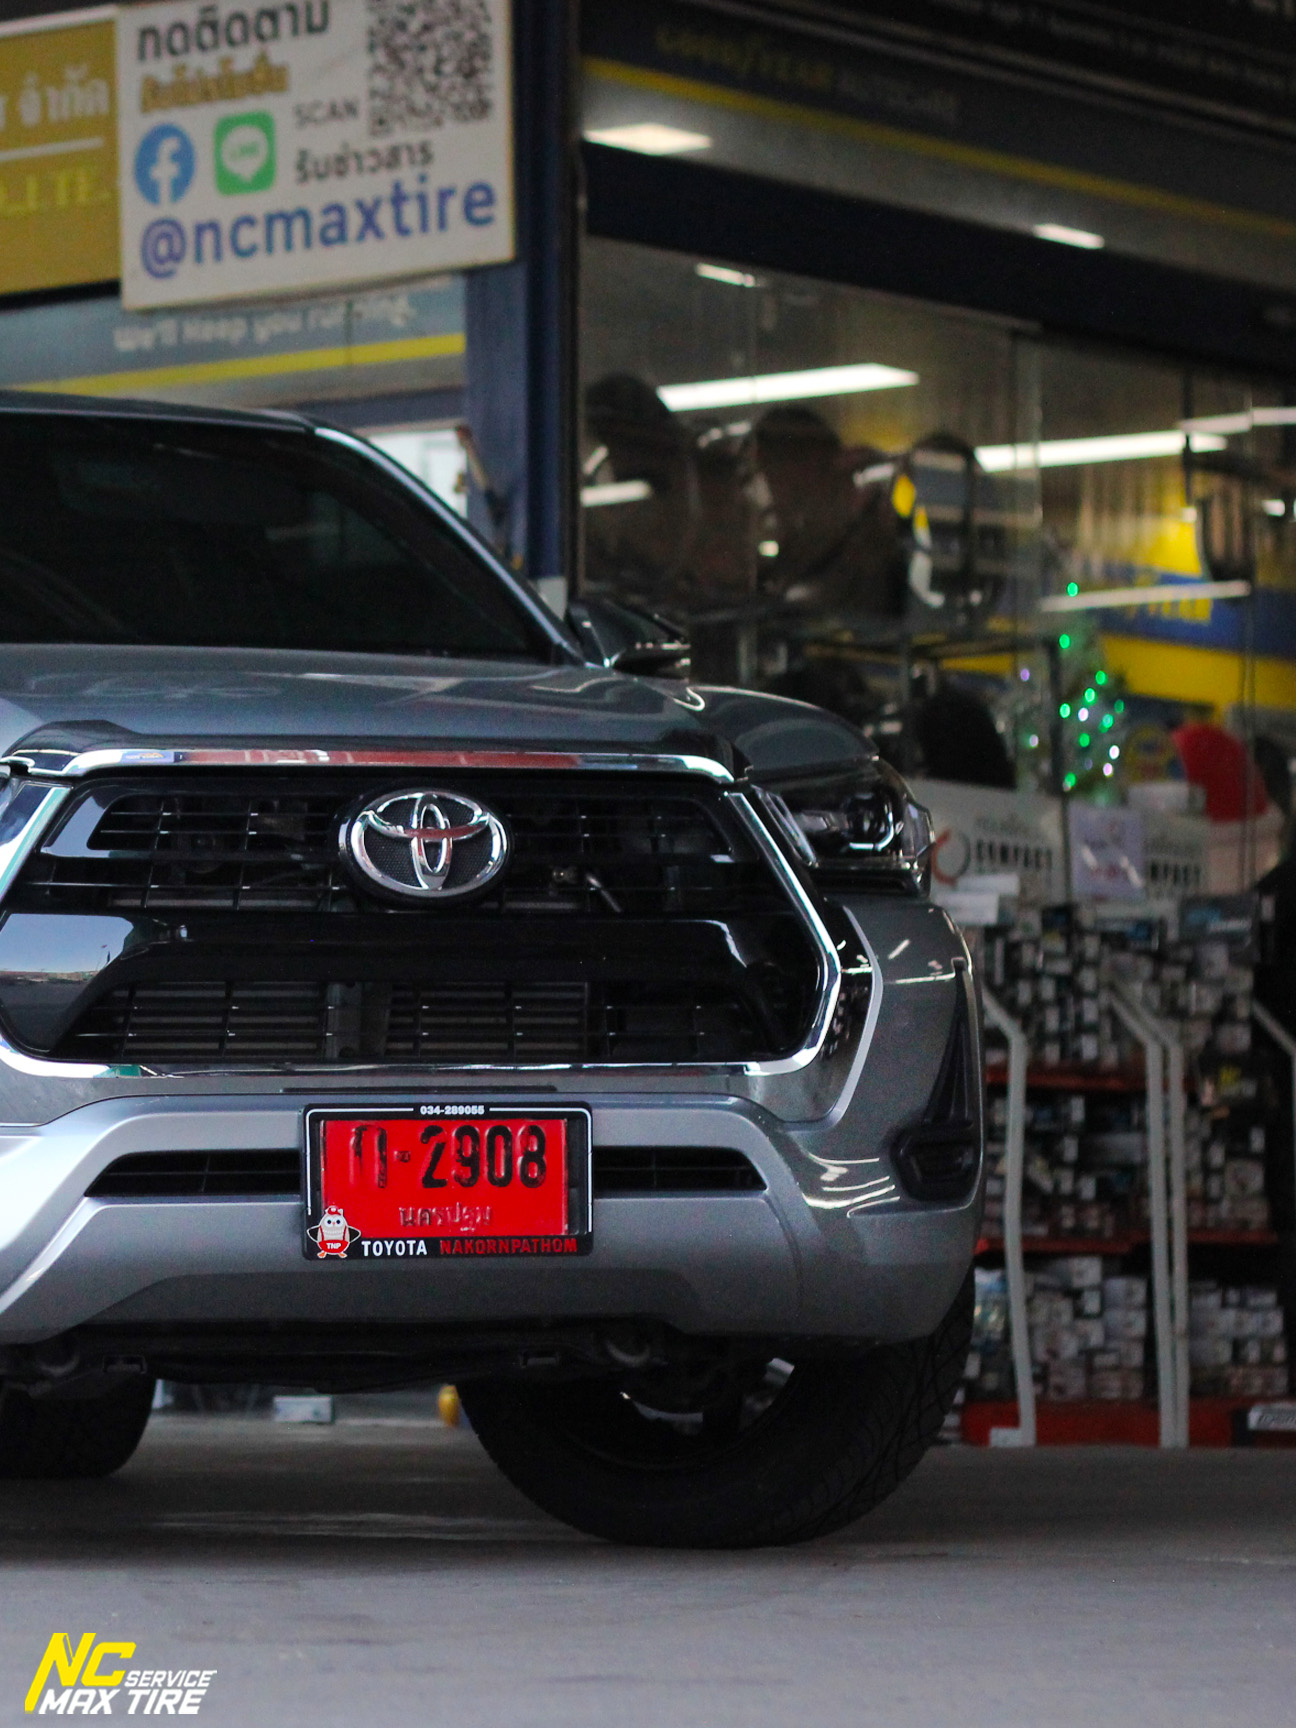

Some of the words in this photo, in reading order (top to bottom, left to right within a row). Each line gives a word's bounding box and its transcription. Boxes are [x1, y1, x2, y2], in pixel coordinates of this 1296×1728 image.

[295, 98, 360, 129] SCAN
[140, 174, 497, 280] @ncmaxtire
[420, 1105, 485, 1115] 034-289055
[361, 1240, 428, 1257] TOYOTA
[440, 1238, 578, 1255] NAKORNPATHOM
